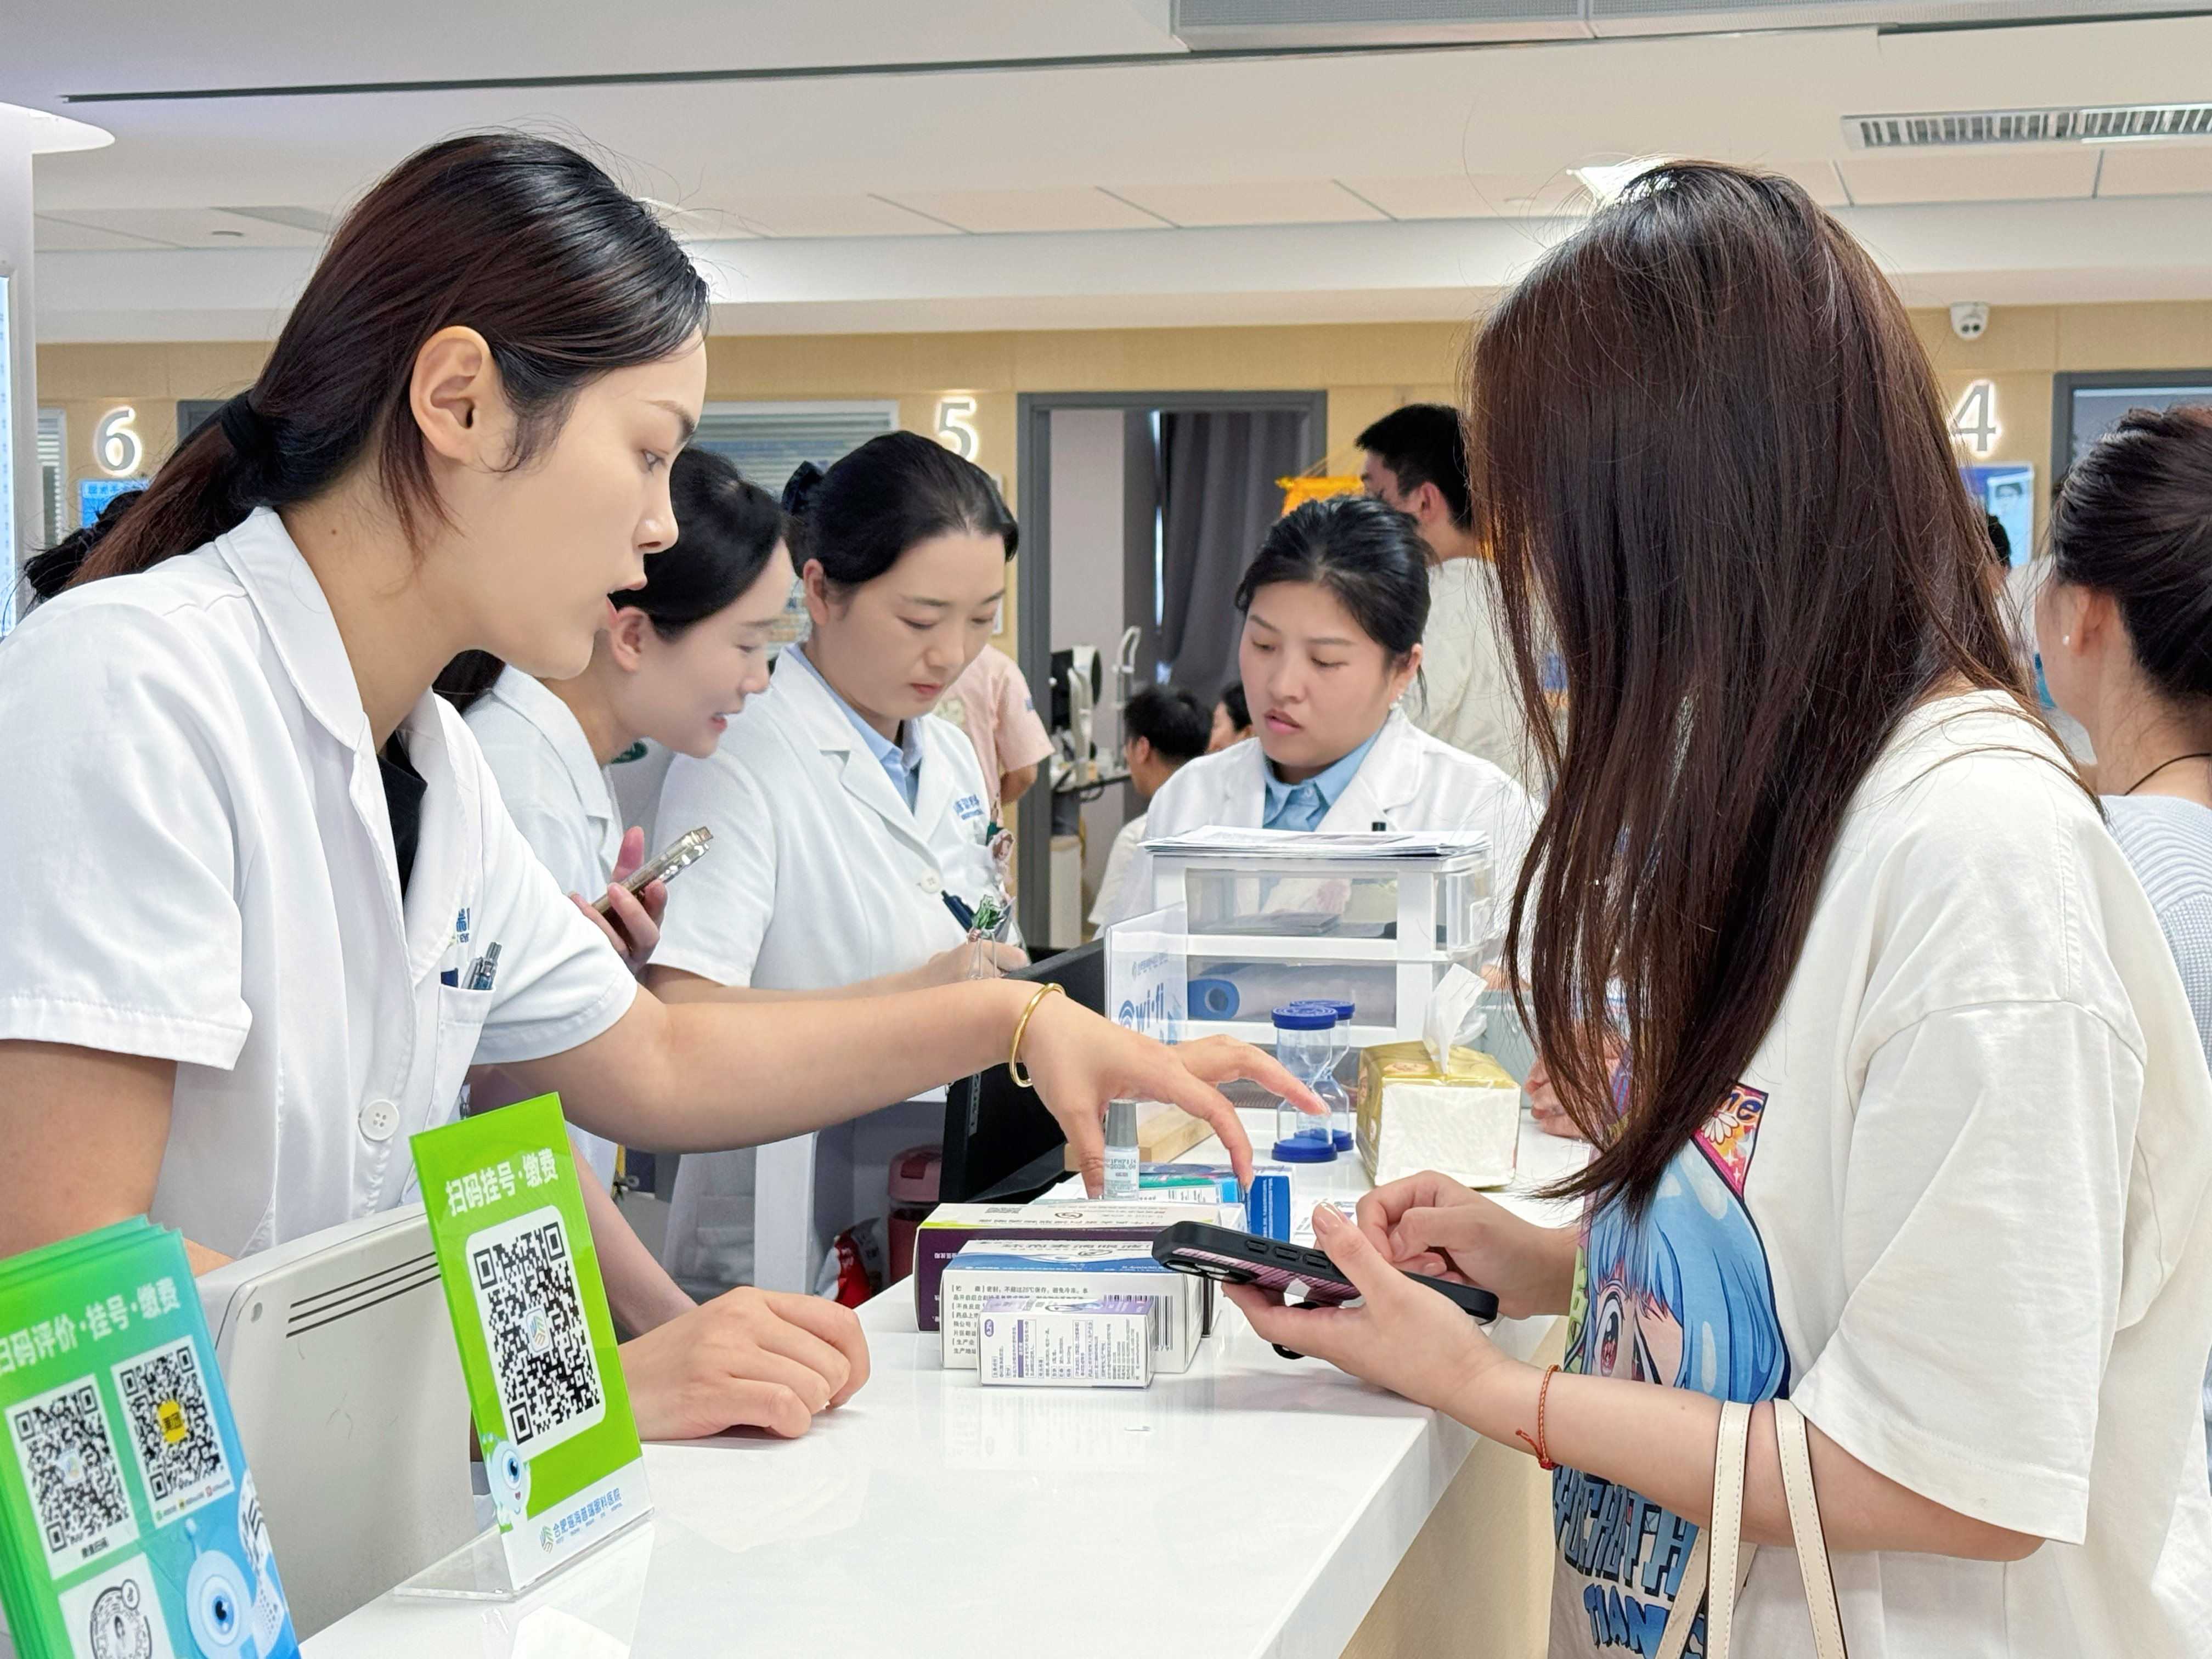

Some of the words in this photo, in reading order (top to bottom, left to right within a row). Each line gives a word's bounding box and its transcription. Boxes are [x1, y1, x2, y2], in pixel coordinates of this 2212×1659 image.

[95, 408, 138, 473] 6
[938, 400, 973, 460] 5
[1950, 383, 1998, 453] 4
[445, 1148, 558, 1217] 扫码挂号·缴费
